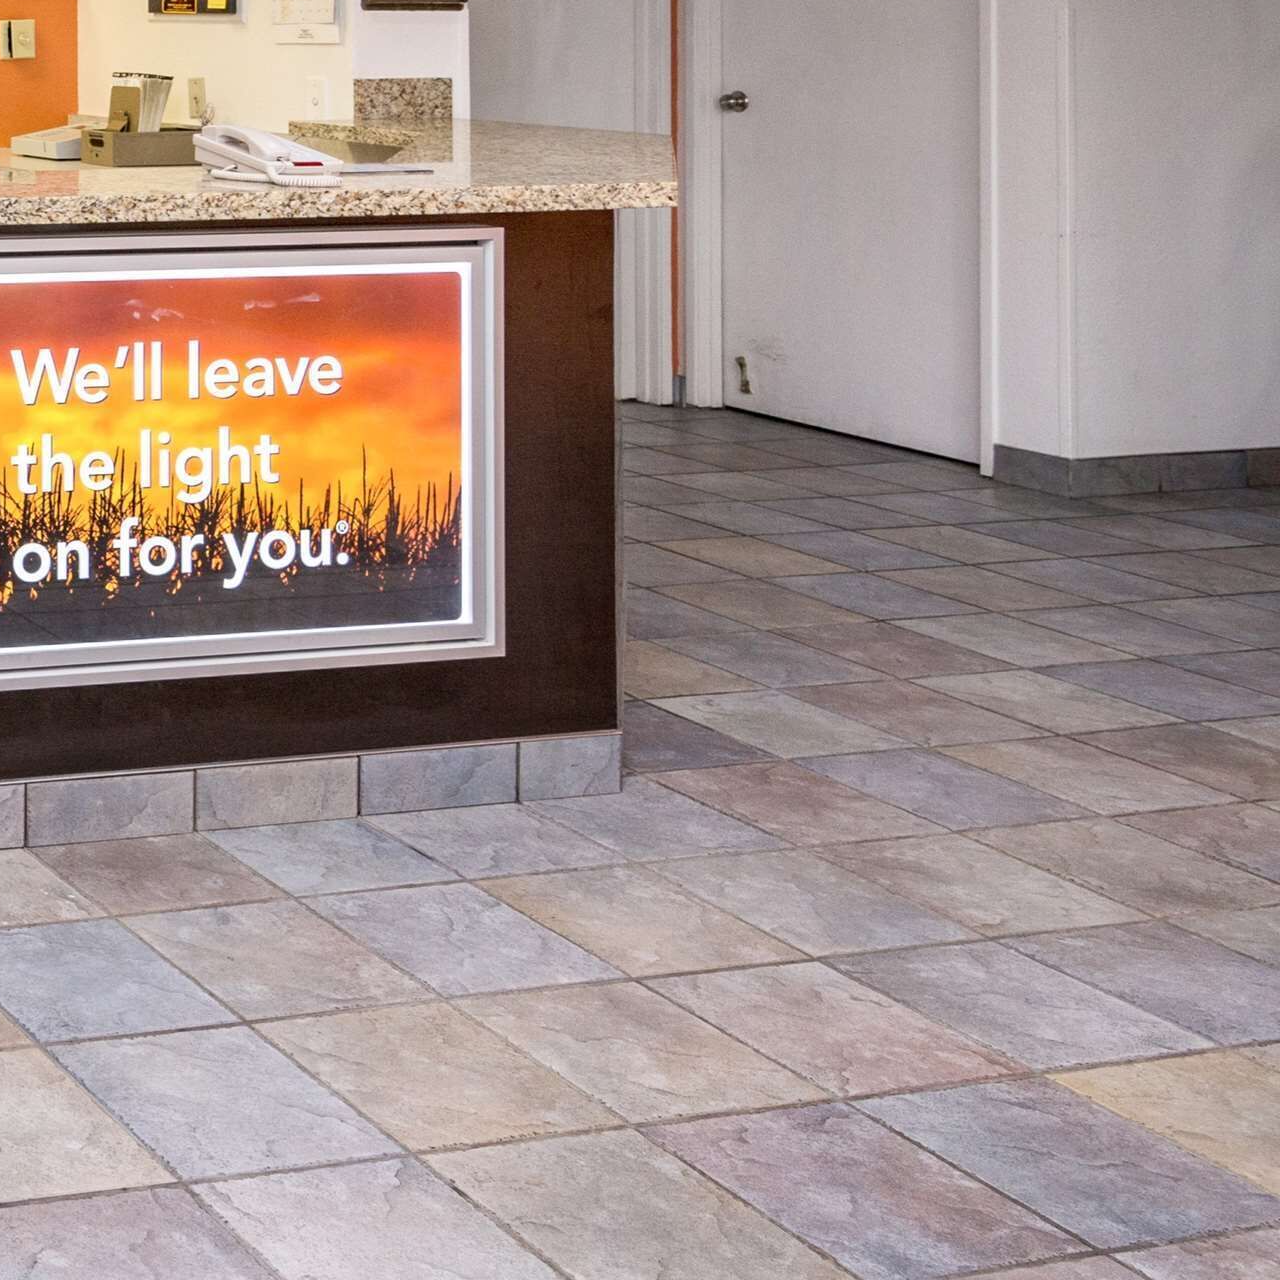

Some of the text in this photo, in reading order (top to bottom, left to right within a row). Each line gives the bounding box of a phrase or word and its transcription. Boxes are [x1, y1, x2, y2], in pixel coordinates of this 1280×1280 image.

[10, 339, 343, 405] We’ll leave
[10, 425, 280, 505] the light
[13, 539, 89, 583] on
[112, 516, 205, 577] for
